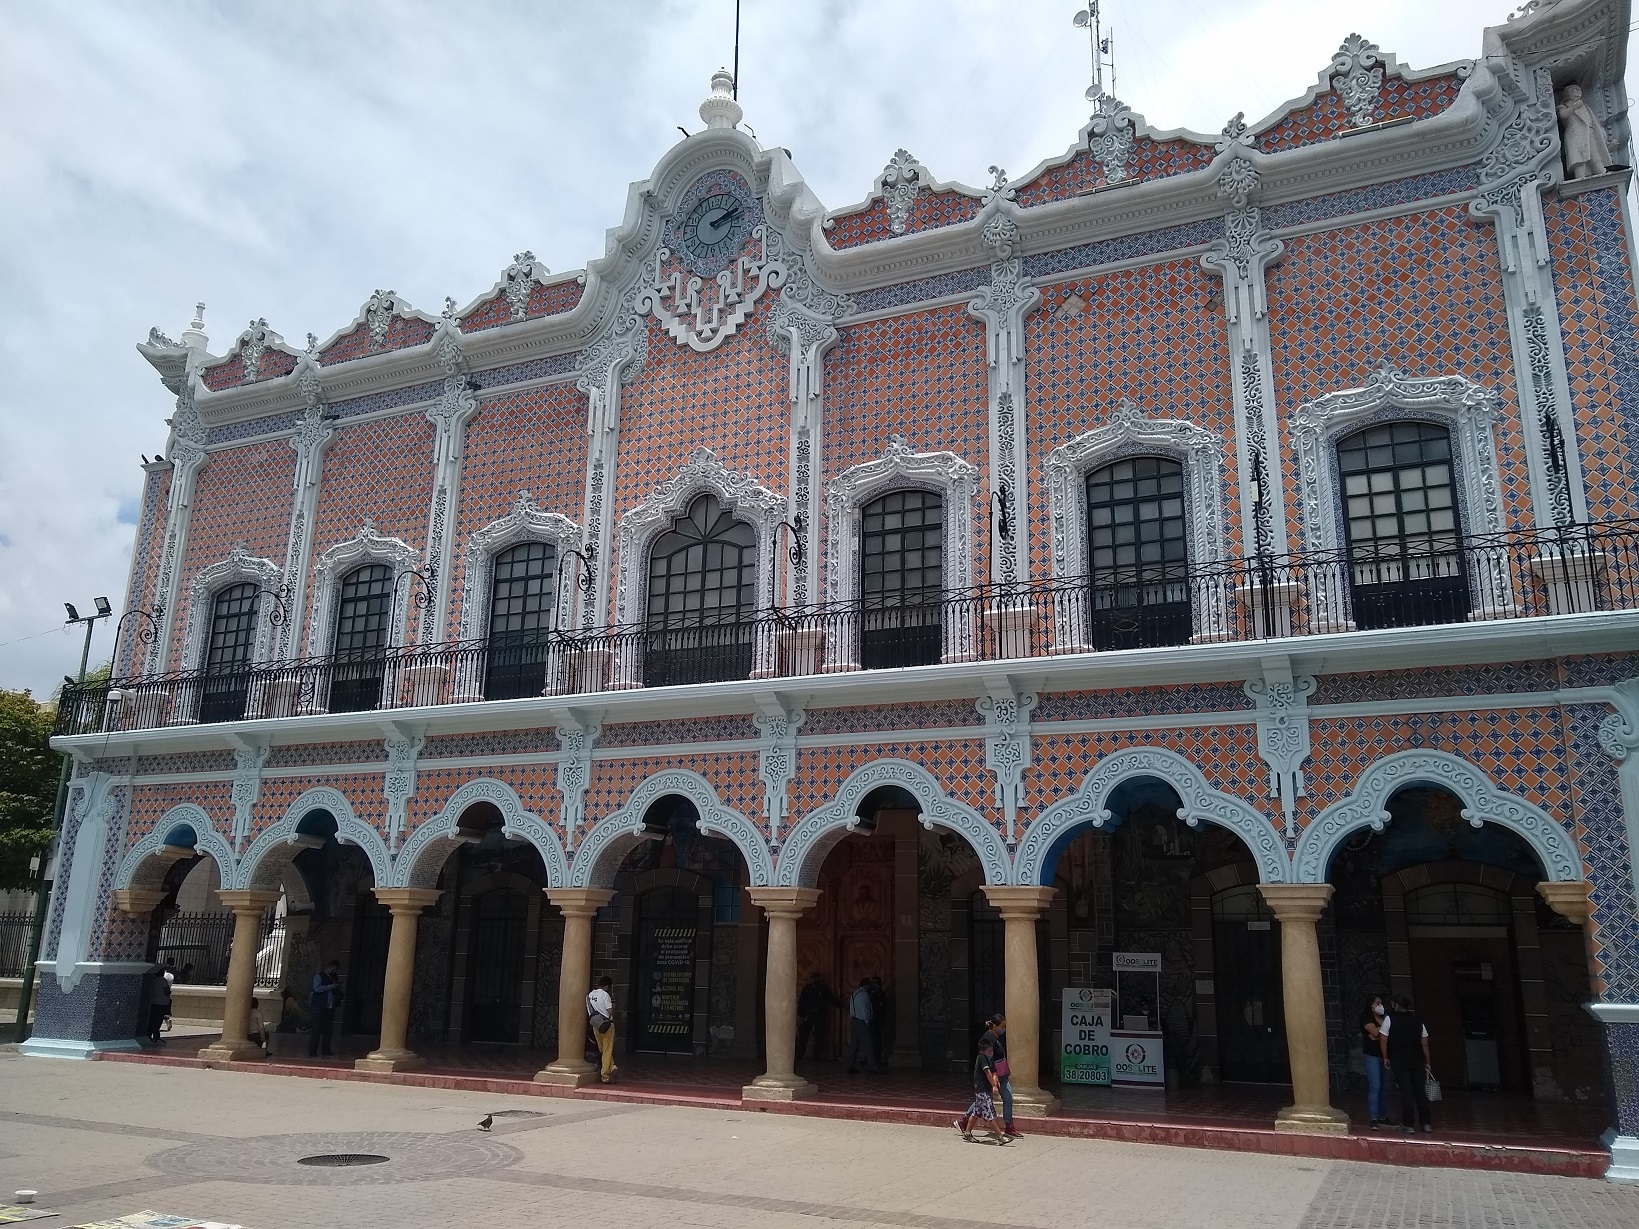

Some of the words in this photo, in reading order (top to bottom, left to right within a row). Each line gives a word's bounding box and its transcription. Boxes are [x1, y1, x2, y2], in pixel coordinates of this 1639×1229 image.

[1070, 1014, 1104, 1027] CAJA
[1078, 1029, 1096, 1042] DE
[1064, 1043, 1109, 1057] COBRO
